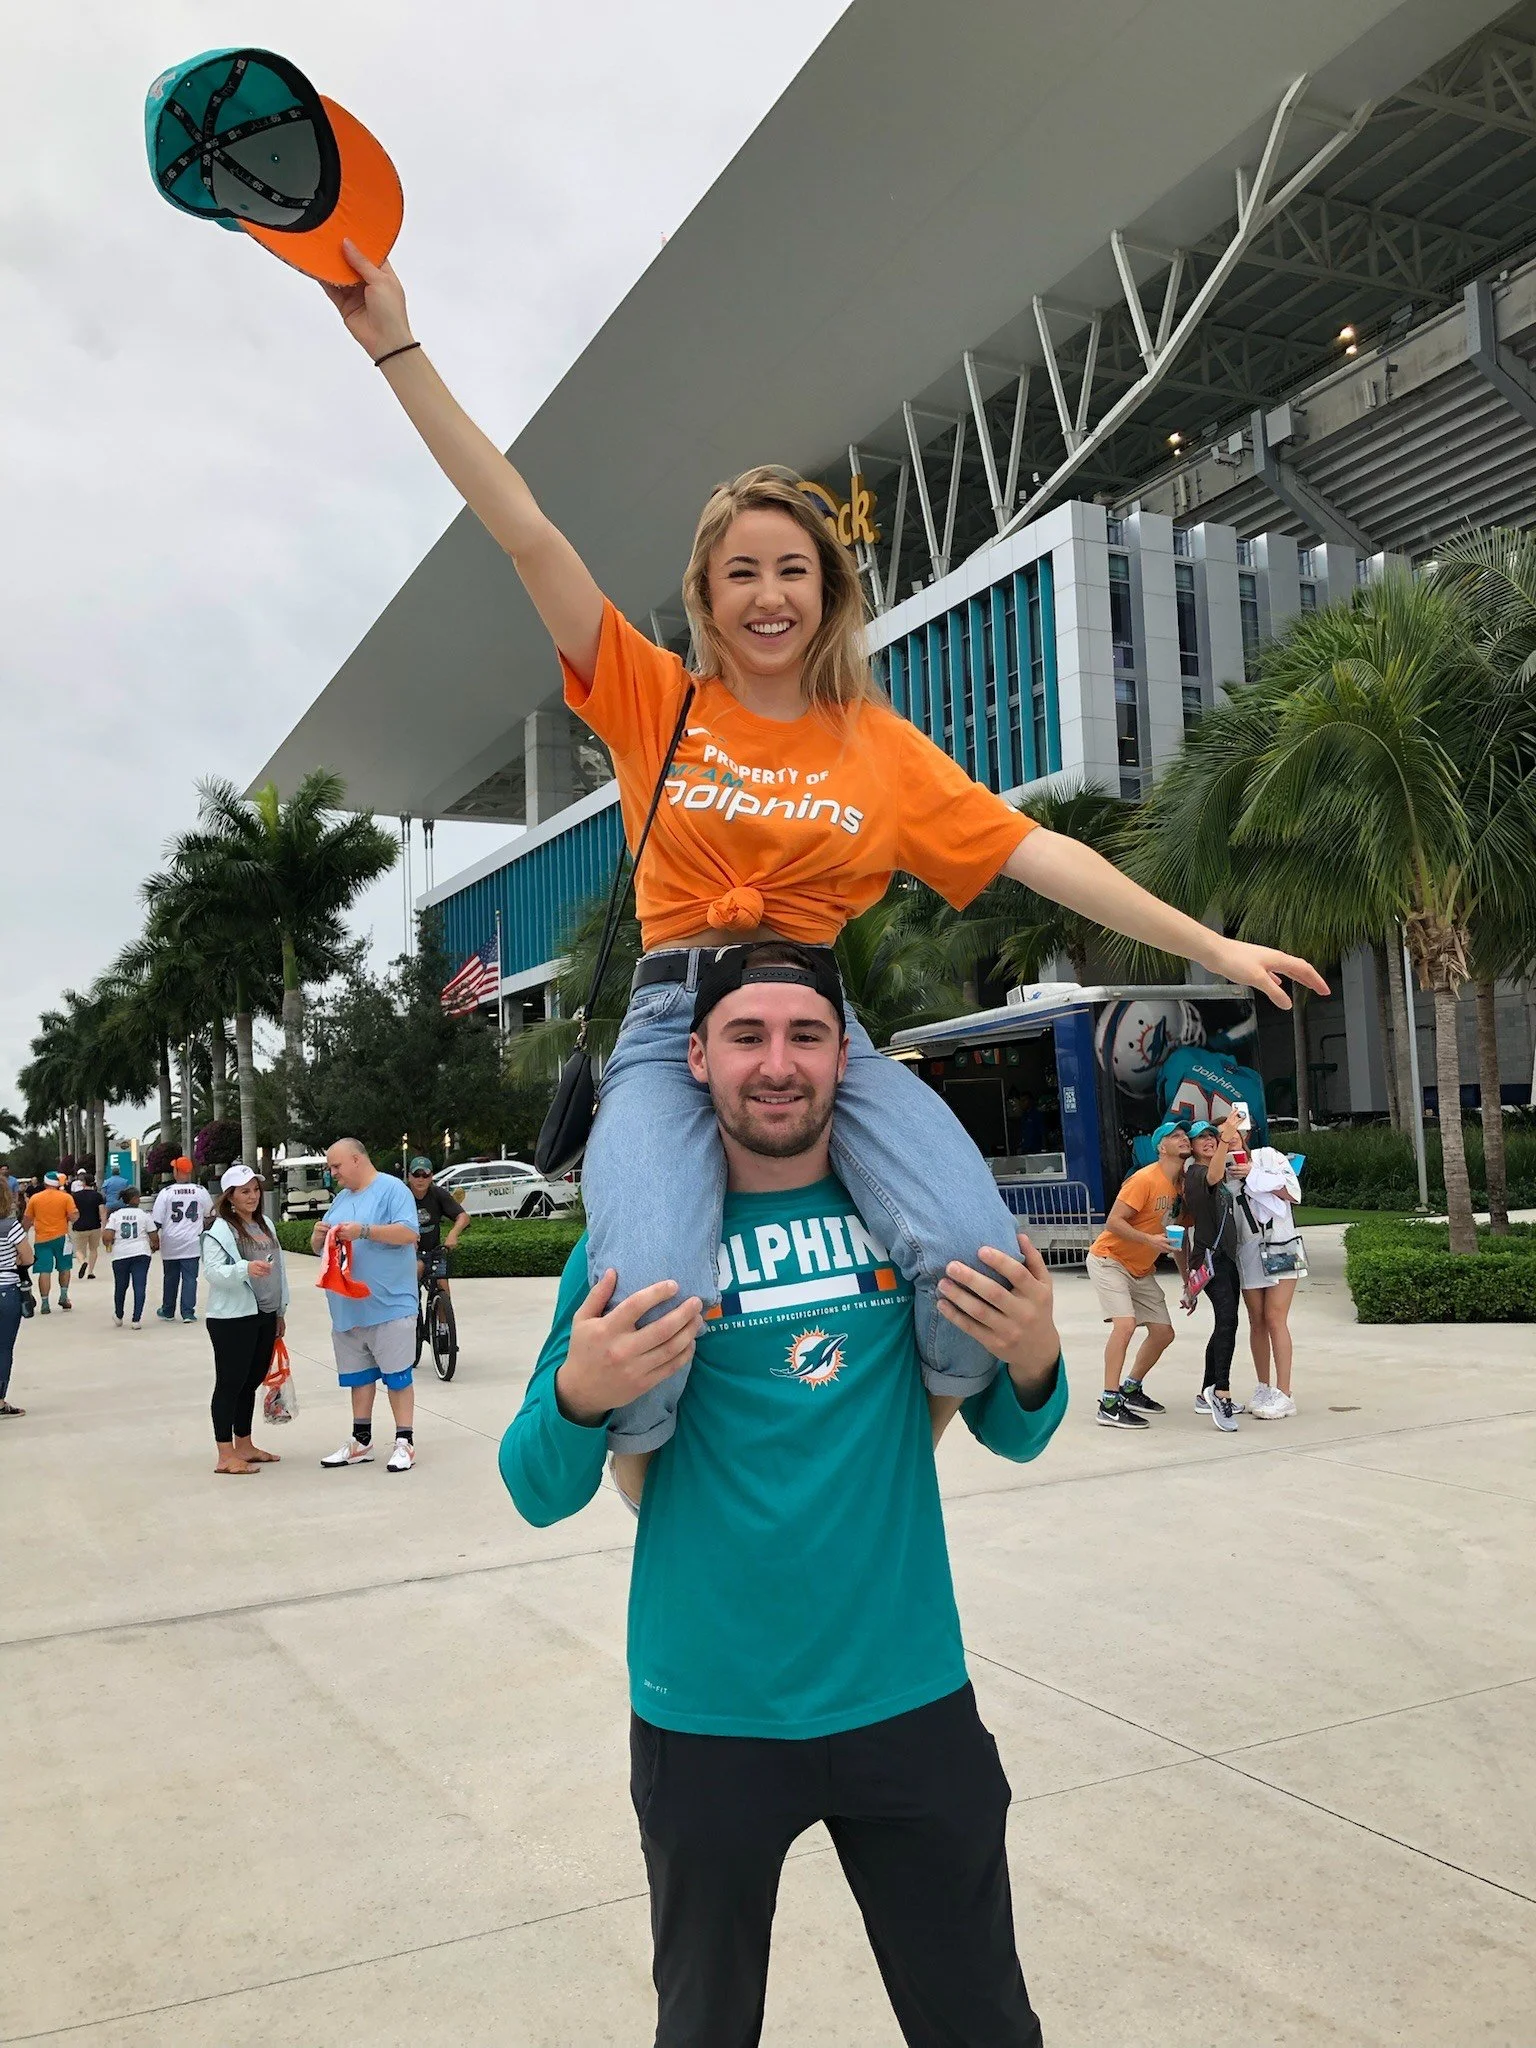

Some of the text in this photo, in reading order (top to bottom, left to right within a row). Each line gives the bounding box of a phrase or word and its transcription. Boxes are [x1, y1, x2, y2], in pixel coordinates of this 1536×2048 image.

[668, 763, 753, 788] MIAM
[703, 744, 829, 785] PROPERTY OF
[1191, 1064, 1243, 1099] dolphins
[110, 1154, 119, 1166] E
[488, 1187, 514, 1196] POLIC
[171, 1200, 199, 1223] 54
[120, 1222, 138, 1239] 91
[719, 1323, 729, 1331] TO
[732, 1320, 746, 1329] THE
[748, 1316, 773, 1327] EXACT
[776, 1306, 839, 1323] SPECIFICATIONS
[841, 1303, 851, 1312] OF
[854, 1301, 868, 1309] THE
[870, 1297, 894, 1307] MIAMI
